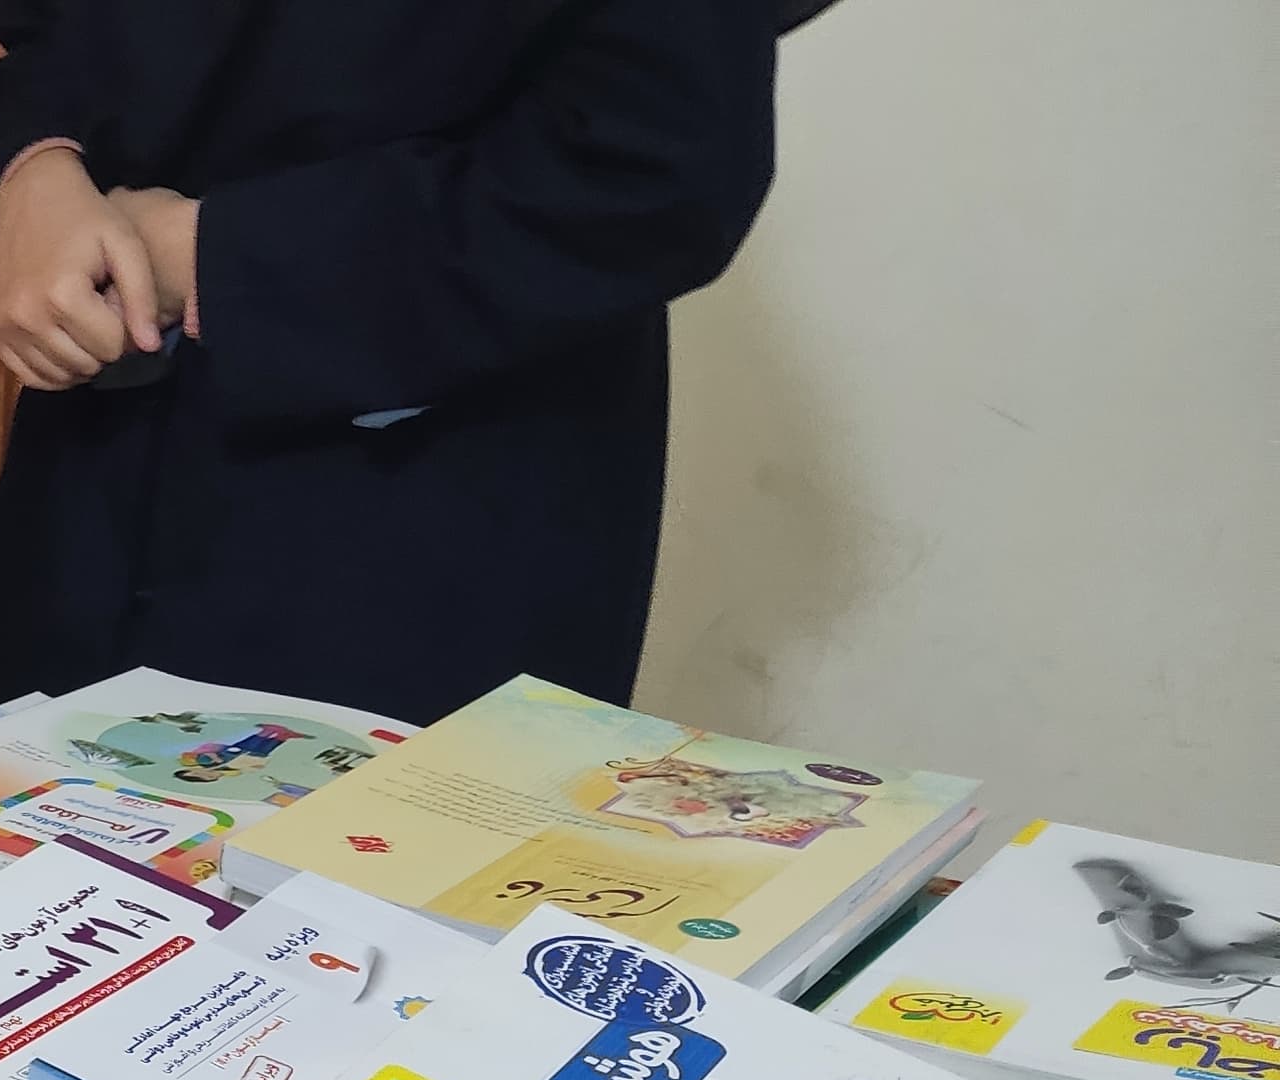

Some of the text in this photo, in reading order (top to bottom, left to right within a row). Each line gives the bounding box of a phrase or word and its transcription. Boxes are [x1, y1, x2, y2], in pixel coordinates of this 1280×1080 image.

[37, 803, 137, 832] هفتم
[55, 883, 100, 914] مجموعه
[495, 879, 646, 910] فارسی
[264, 924, 322, 965] ویژه پایه
